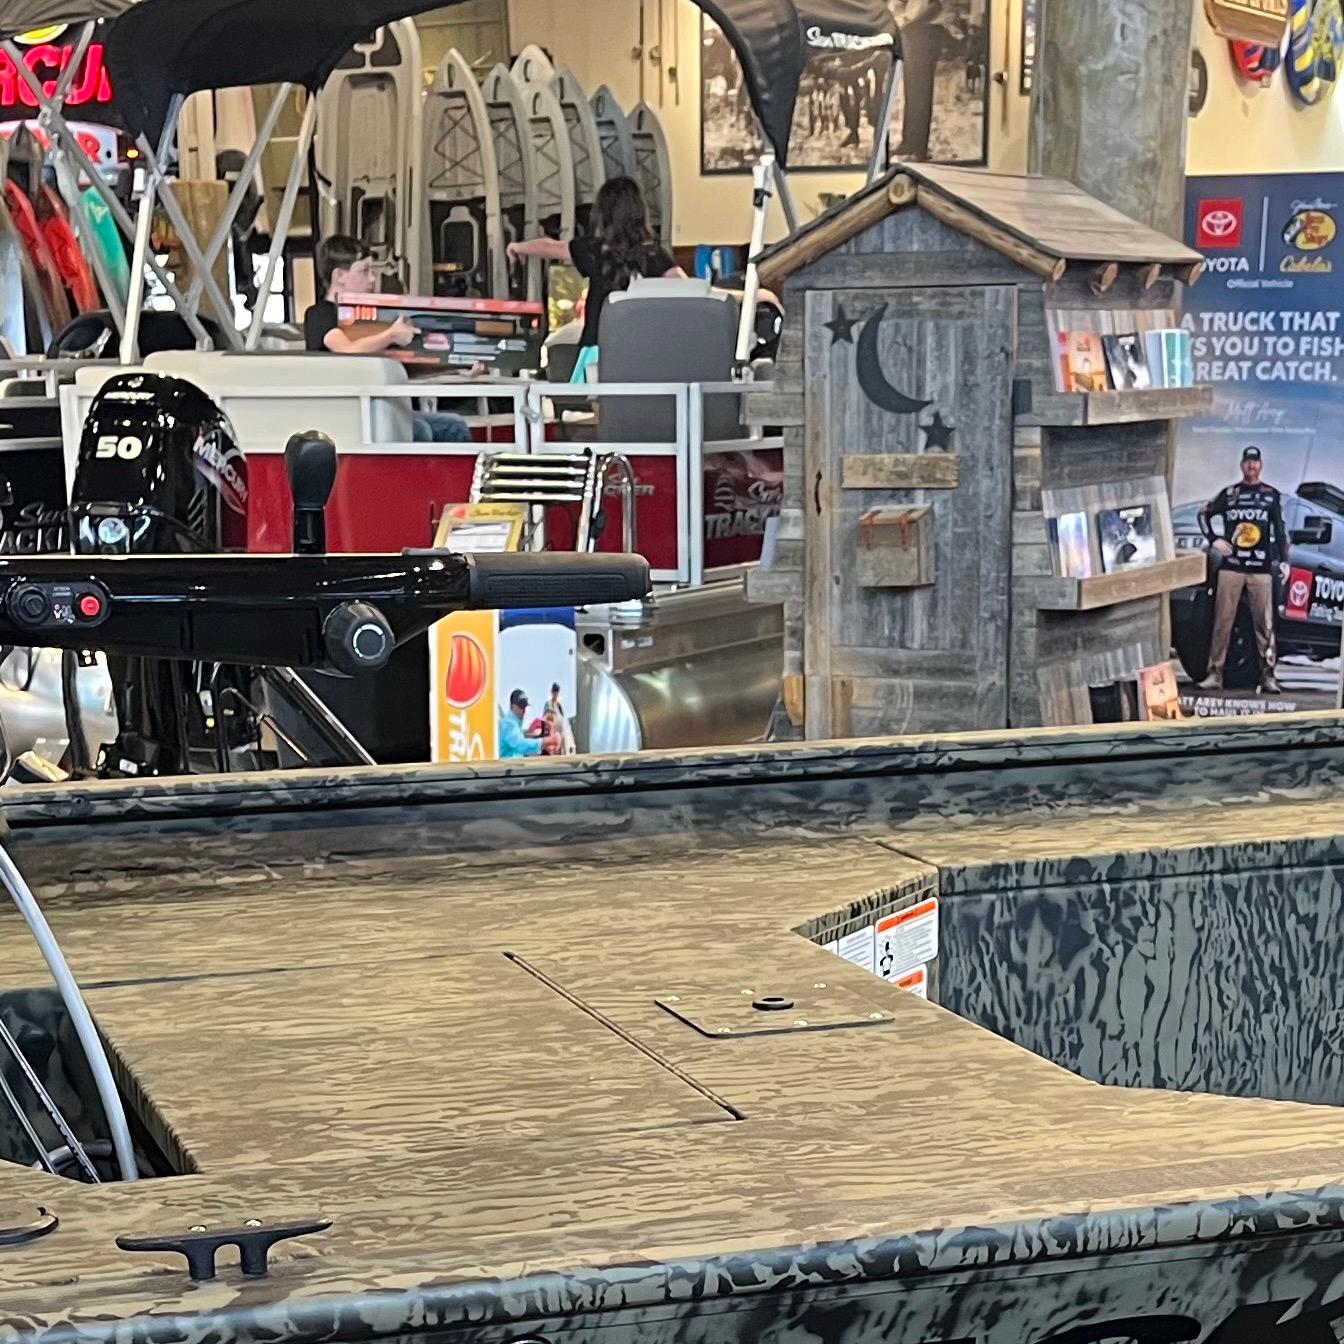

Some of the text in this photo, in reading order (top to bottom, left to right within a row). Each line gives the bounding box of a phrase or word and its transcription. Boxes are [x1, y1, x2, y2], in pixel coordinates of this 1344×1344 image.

[1201, 257, 1250, 273] YOTA
[1180, 311, 1341, 333] A TRUCK THAT
[1211, 336, 1260, 356] YOU
[1263, 336, 1296, 356] TO
[1196, 360, 1338, 382] REAT CATCH.
[95, 436, 143, 460] 50
[1226, 508, 1269, 522] TOYOTA
[1194, 706, 1209, 716] TO
[1268, 701, 1298, 712] HOW
[448, 711, 467, 762] TR
